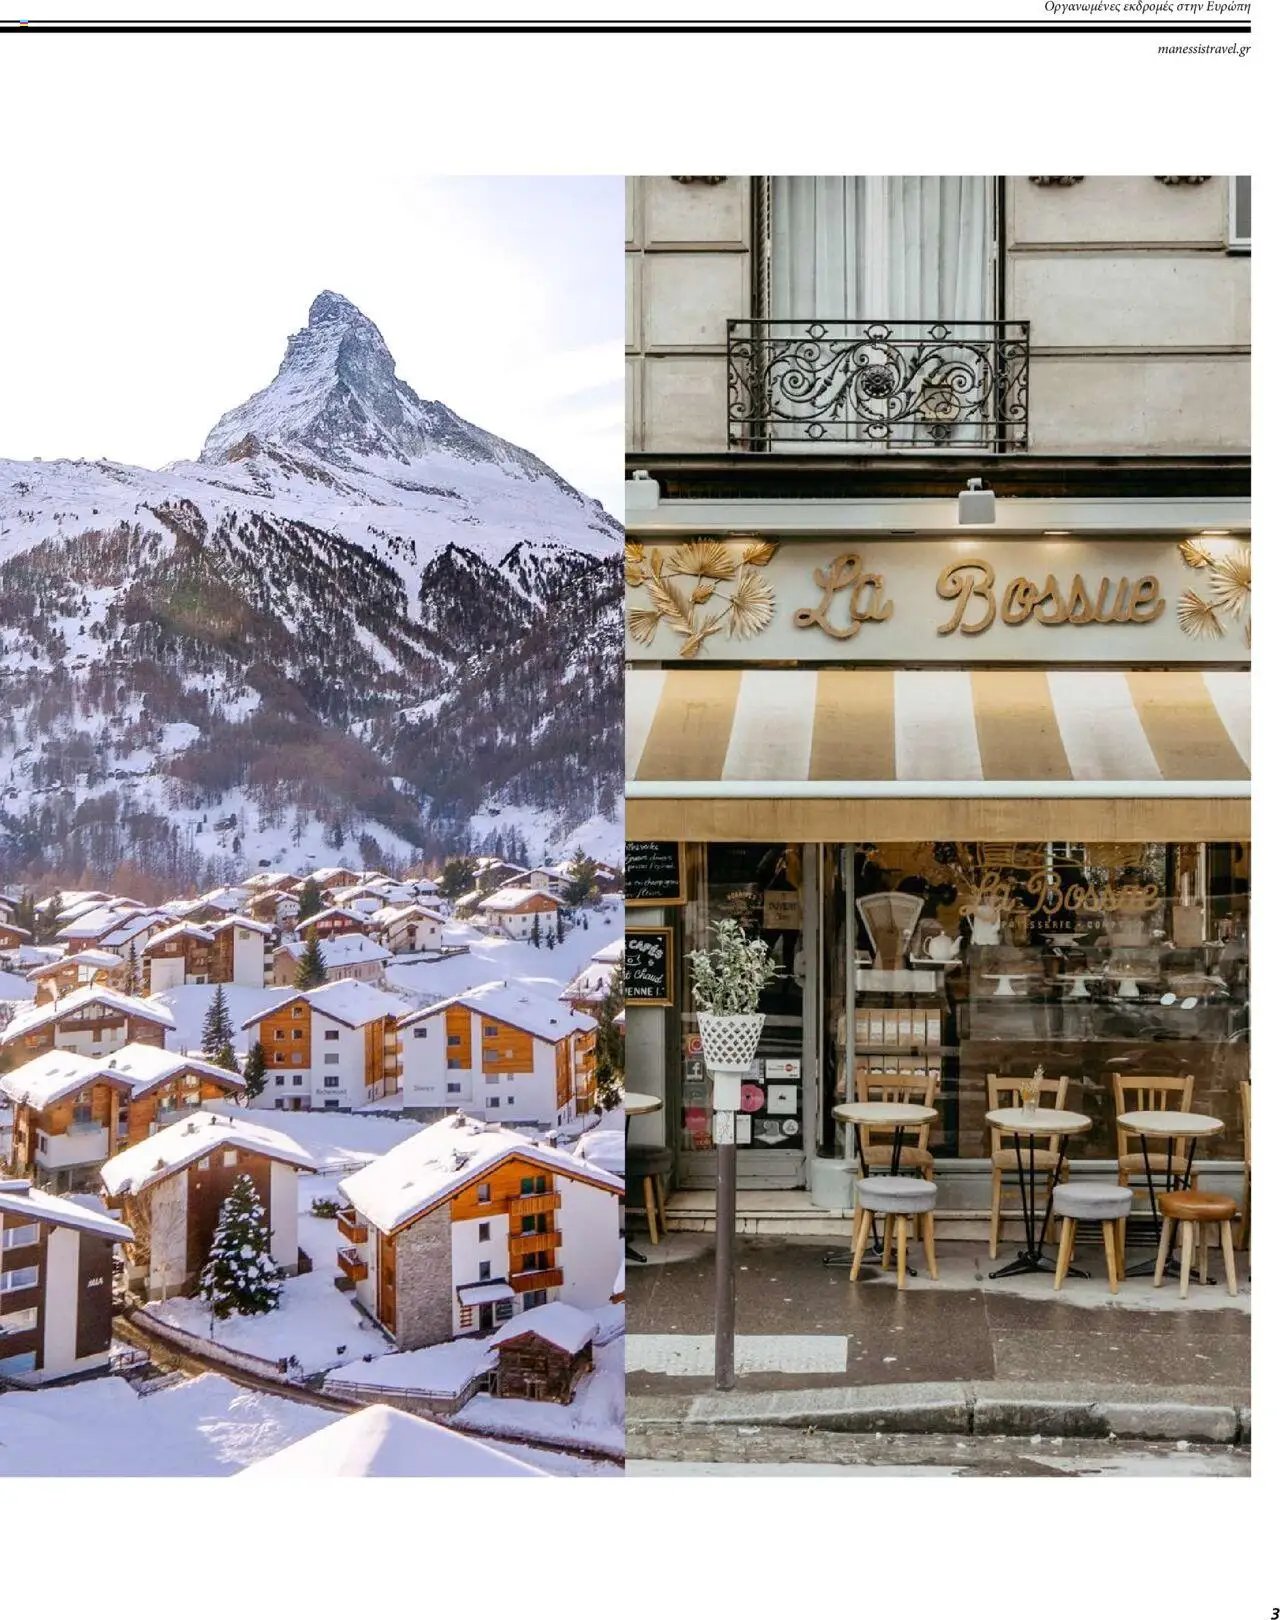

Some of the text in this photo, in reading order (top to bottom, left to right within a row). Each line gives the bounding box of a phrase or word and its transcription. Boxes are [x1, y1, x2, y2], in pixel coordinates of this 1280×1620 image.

[794, 553, 1167, 640] La Bossue
[1001, 920, 1072, 930] PASSERIE
